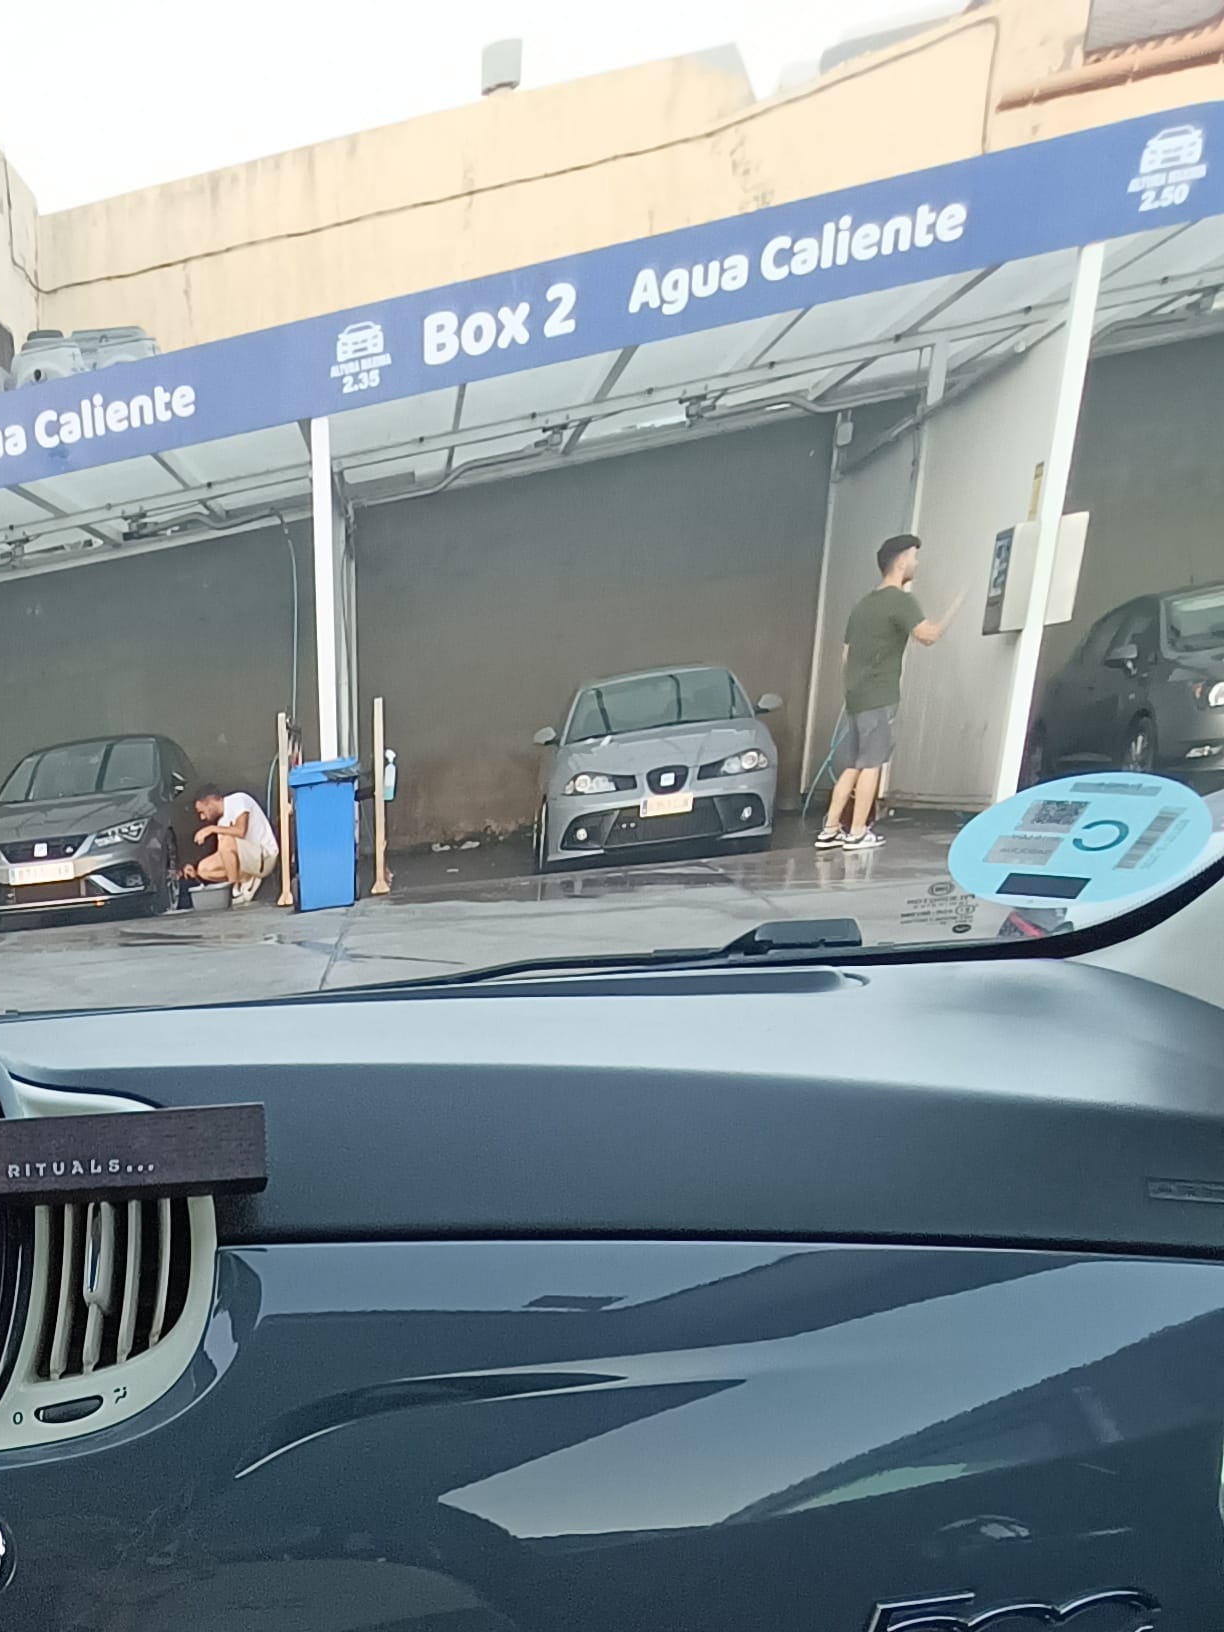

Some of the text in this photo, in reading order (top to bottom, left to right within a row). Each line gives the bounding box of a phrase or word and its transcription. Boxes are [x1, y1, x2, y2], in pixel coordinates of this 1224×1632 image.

[1138, 183, 1190, 212] 2.50
[423, 202, 967, 366] Box 2 Agua Caliente
[342, 369, 381, 393] 2.35
[35, 385, 196, 448] Caliente
